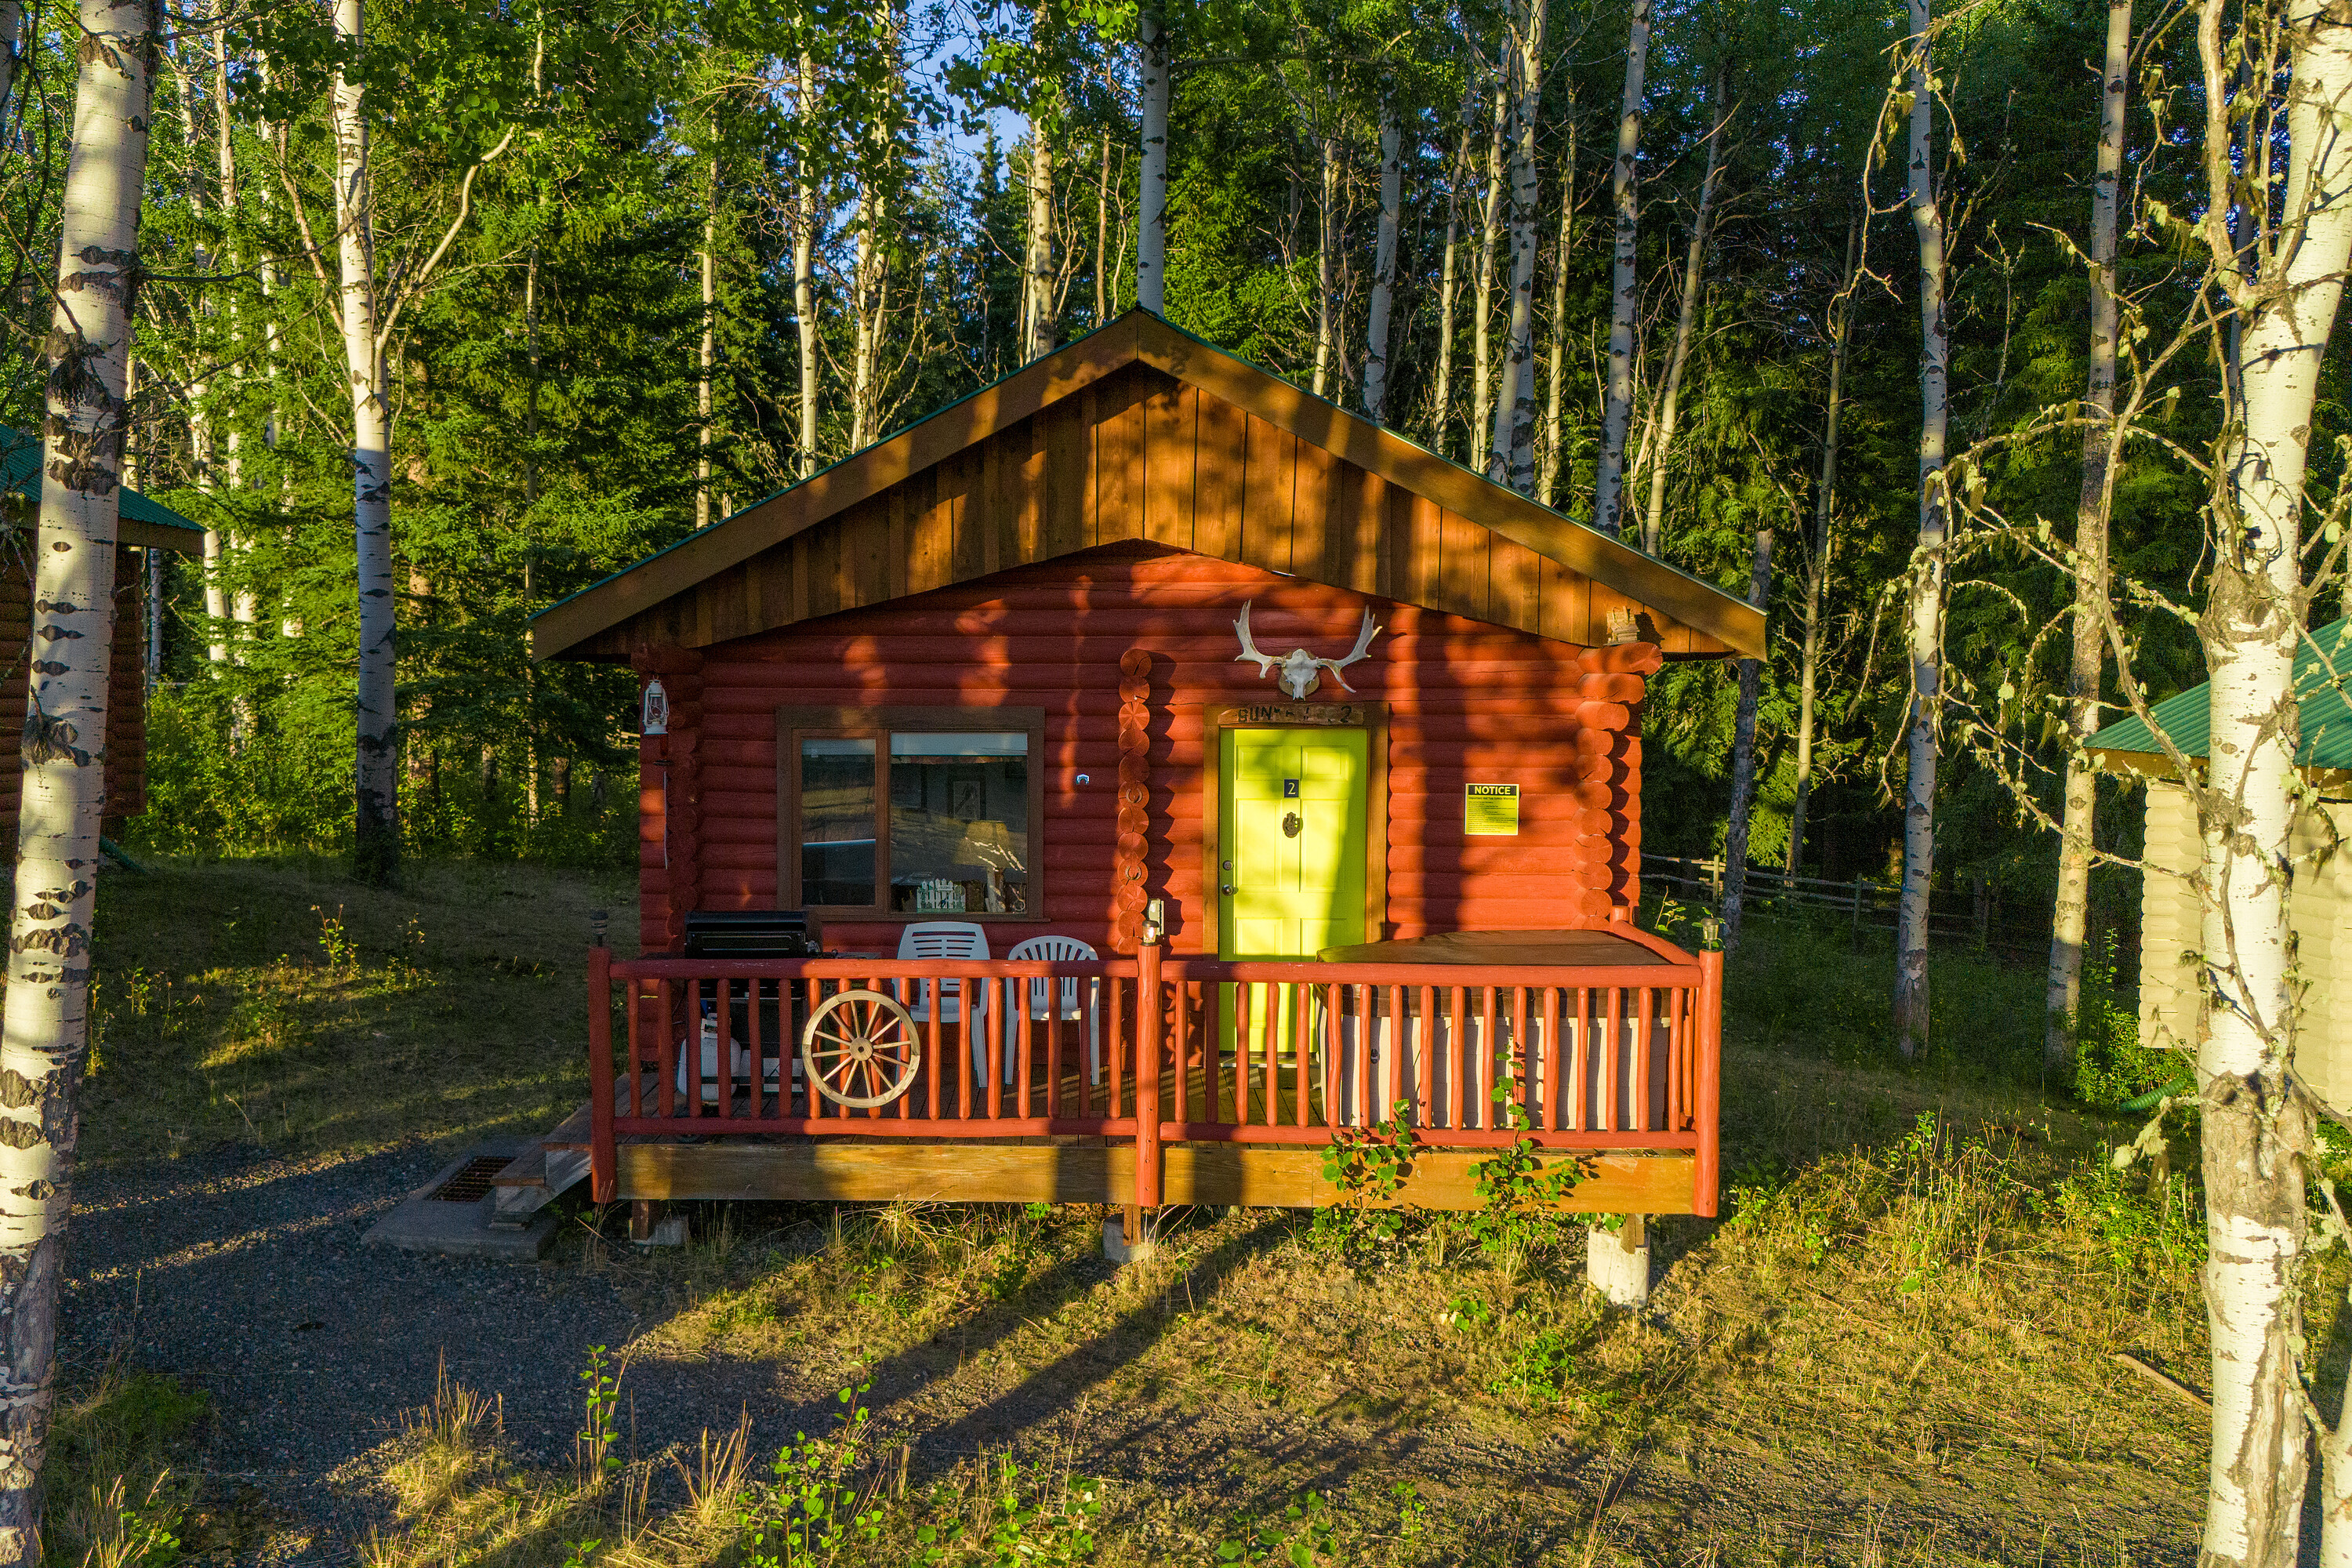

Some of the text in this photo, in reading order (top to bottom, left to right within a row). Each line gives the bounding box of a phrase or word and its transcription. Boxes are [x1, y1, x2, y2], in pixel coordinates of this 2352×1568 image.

[1341, 706, 1352, 723] 2
[1288, 782, 1296, 795] 2
[1474, 786, 1511, 795] NOTICE
